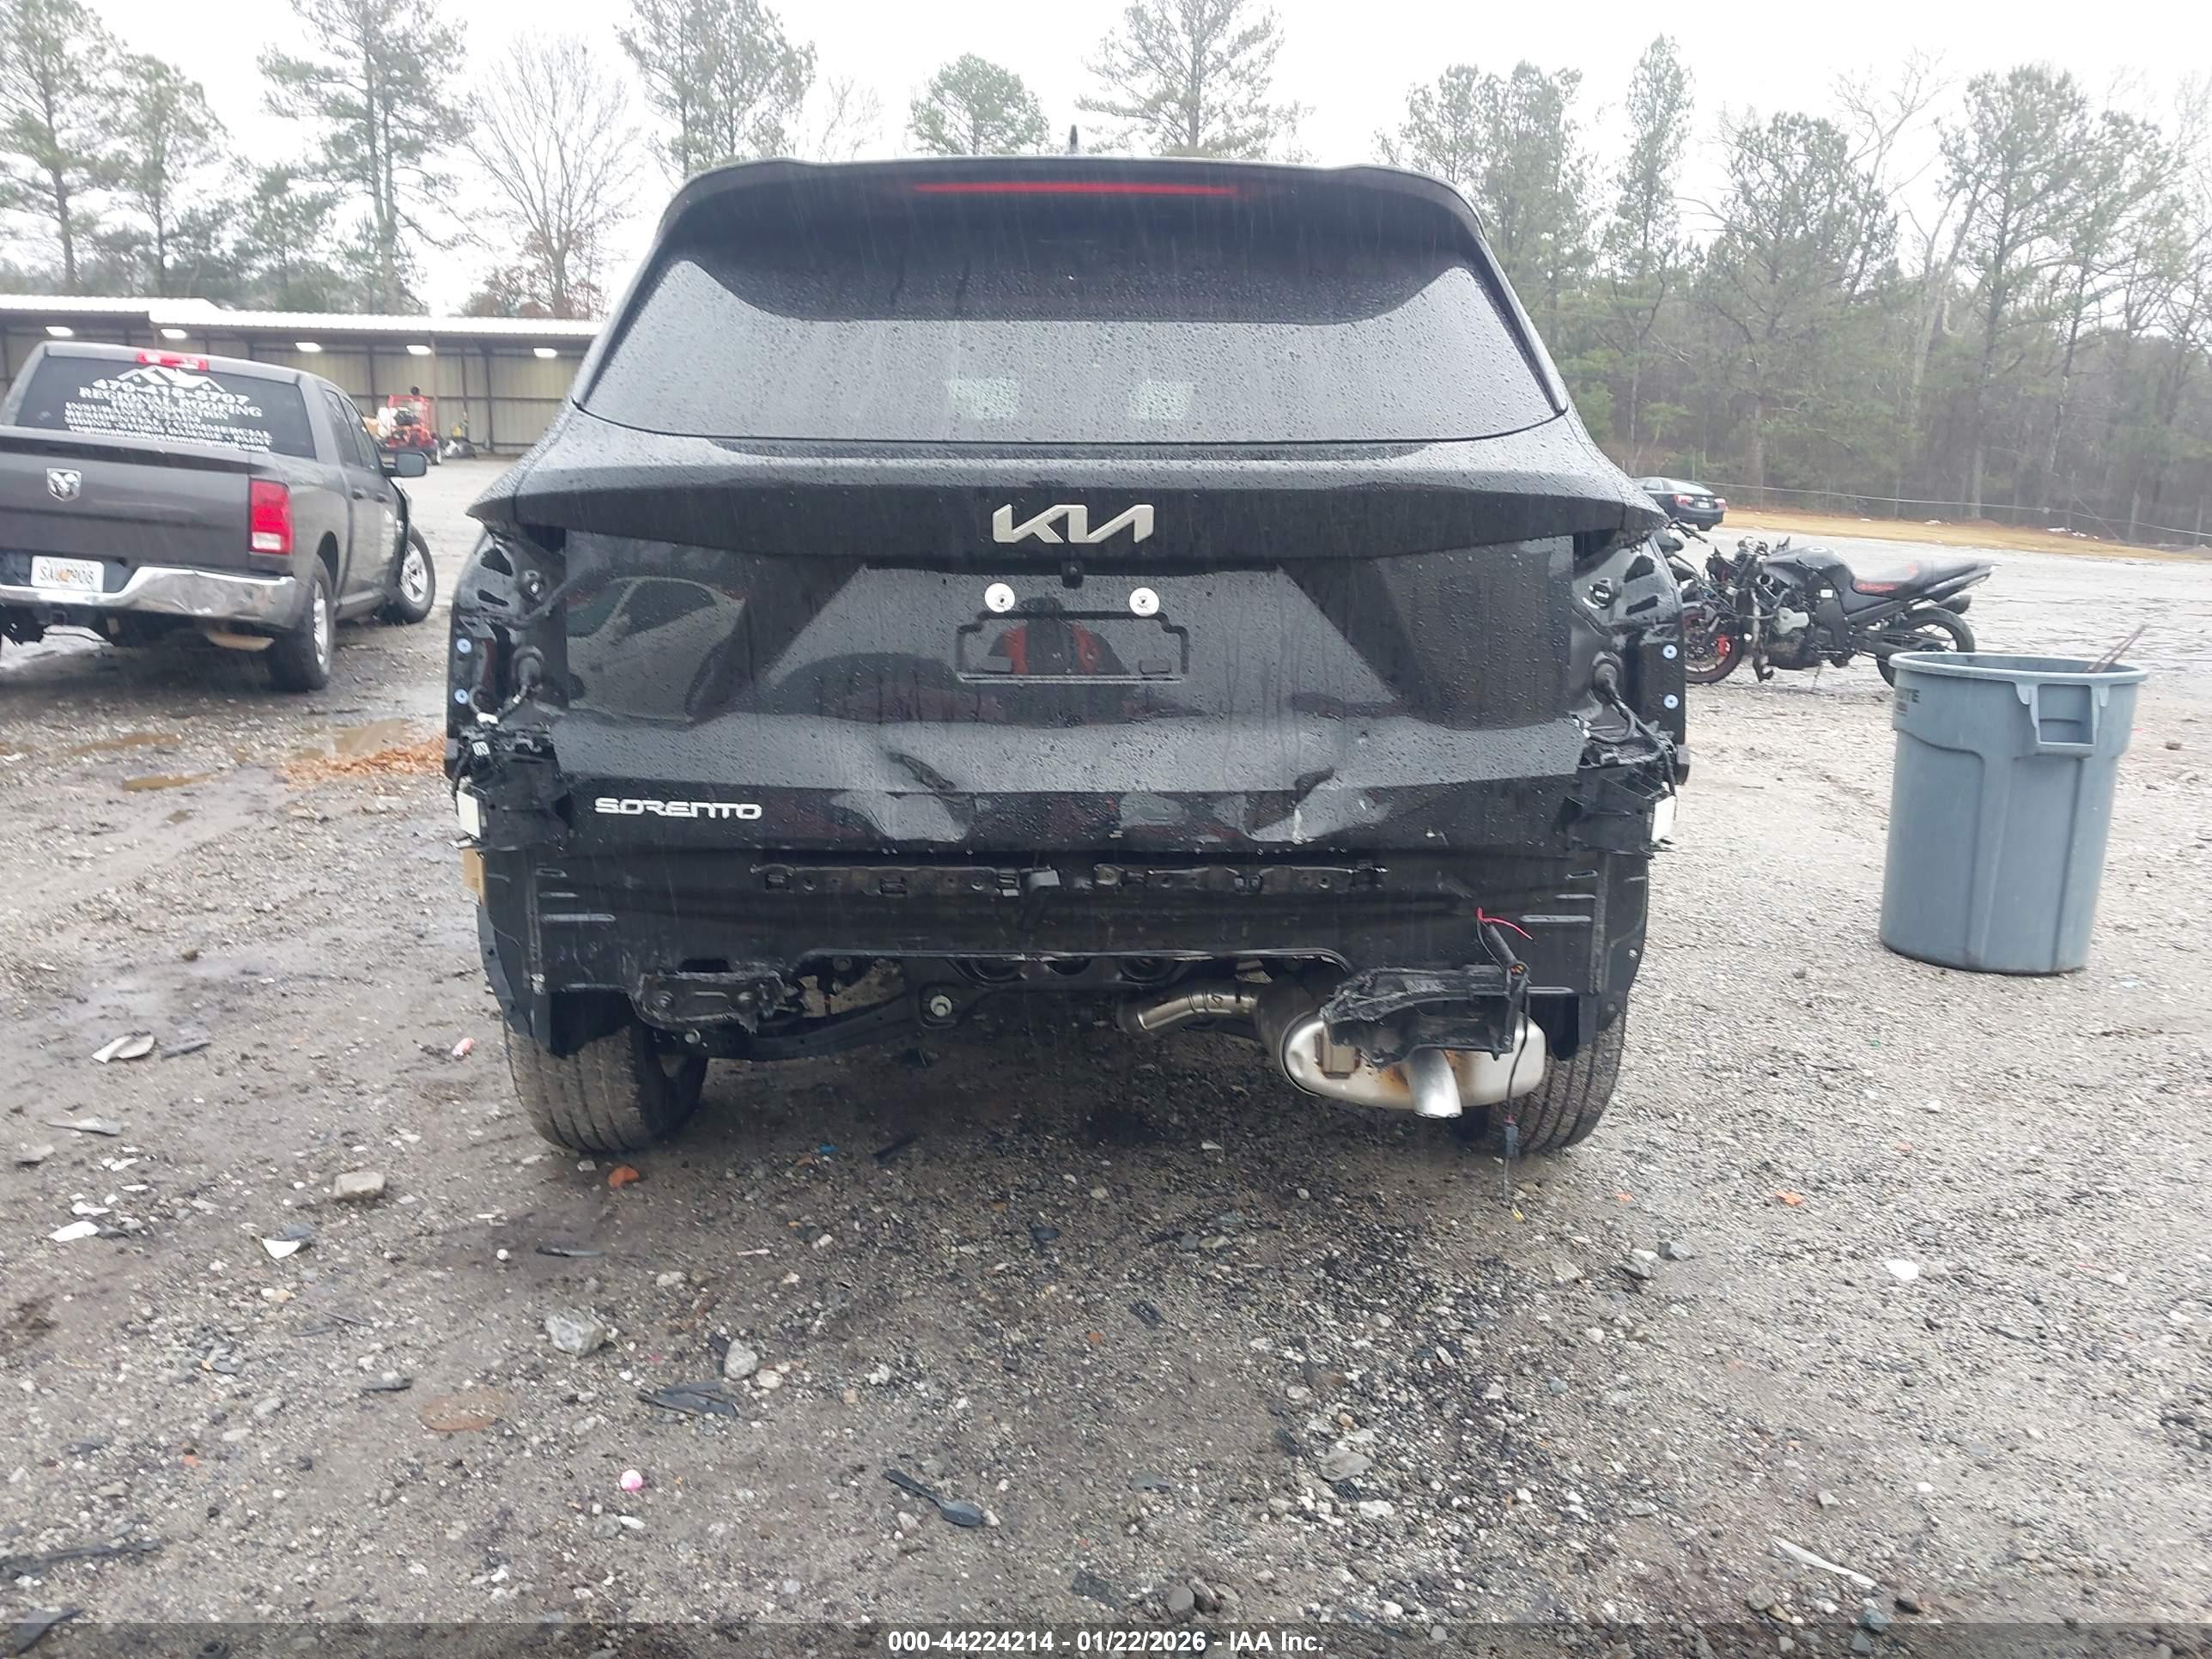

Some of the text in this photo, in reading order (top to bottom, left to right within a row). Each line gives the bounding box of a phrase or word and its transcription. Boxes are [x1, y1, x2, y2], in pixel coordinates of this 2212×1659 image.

[78, 386, 263, 417] REGIONAL ROOFING
[993, 503, 1155, 544] KIA
[594, 797, 763, 820] SORENTO
